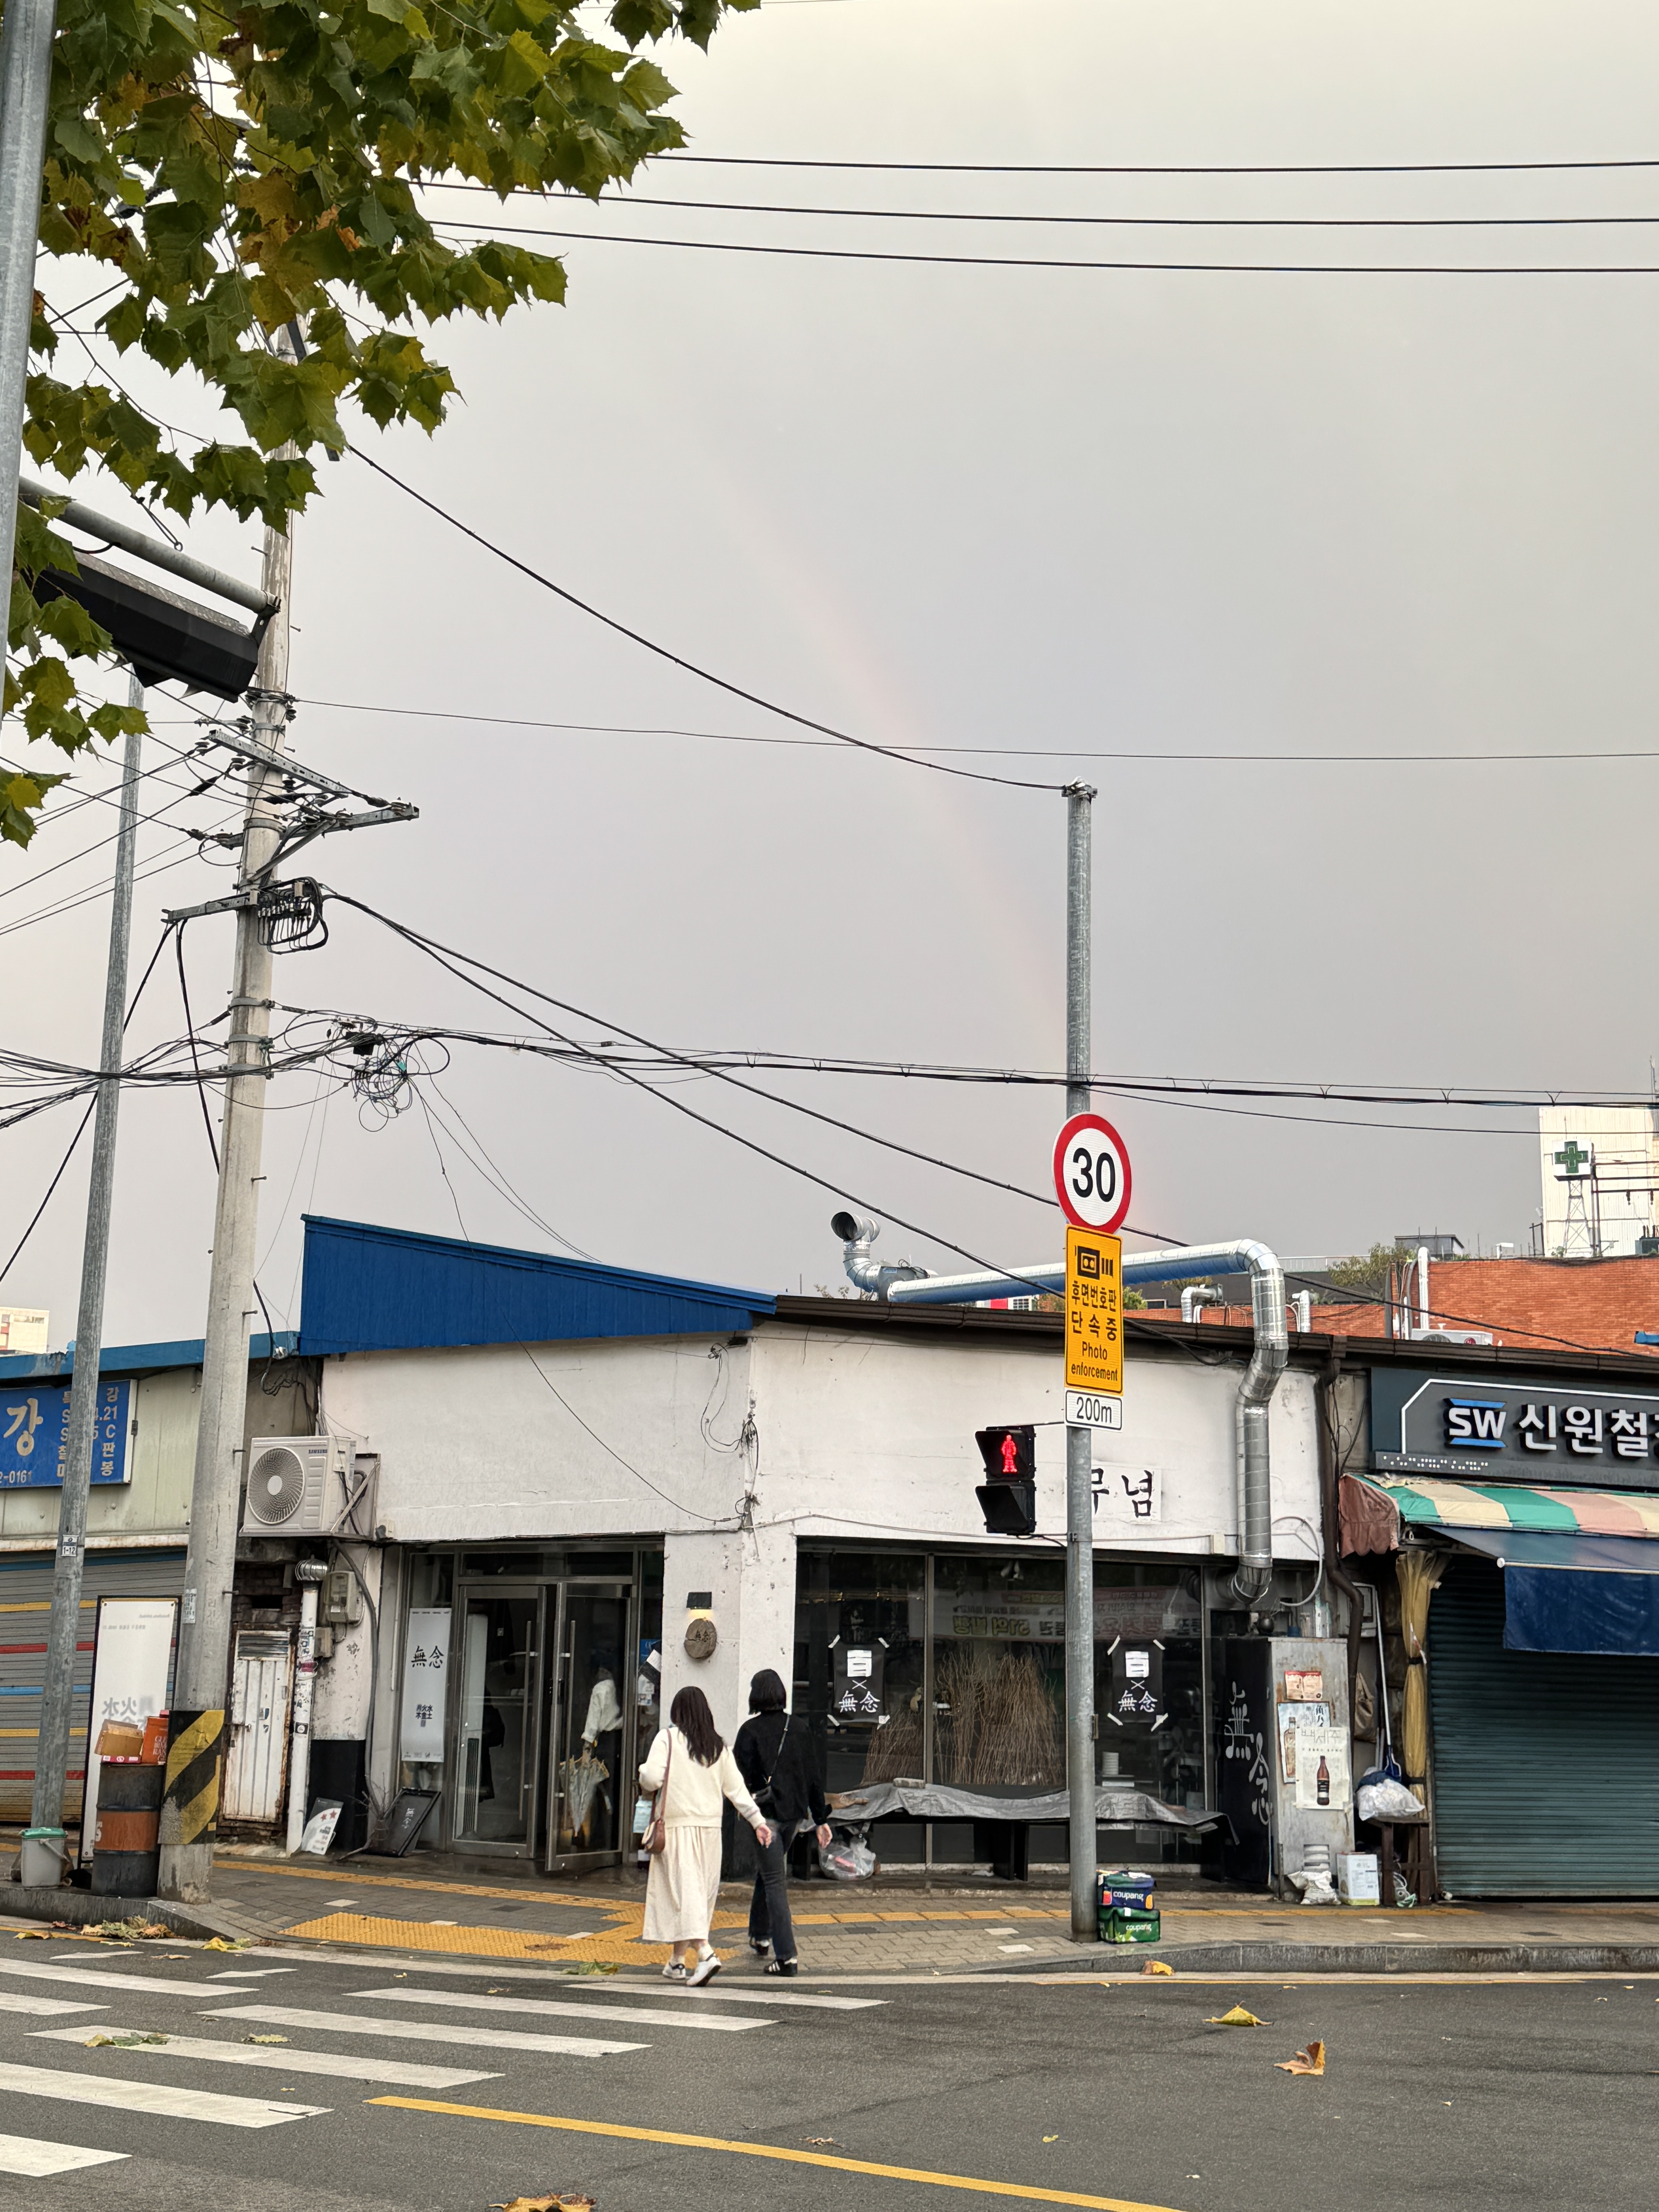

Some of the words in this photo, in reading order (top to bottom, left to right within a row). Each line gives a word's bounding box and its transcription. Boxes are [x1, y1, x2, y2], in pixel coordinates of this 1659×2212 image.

[1072, 1147, 1115, 1202] 30
[1072, 1280, 1116, 1312] 후면번호판
[1082, 1341, 1108, 1360] Photo
[1072, 1362, 1118, 1382] enforcement
[1077, 1396, 1112, 1423] 200m
[1449, 1407, 1507, 1439] SW
[1518, 1404, 1659, 1457] 신원철
[411, 1645, 444, 1669] 無念
[838, 1690, 881, 1713] 無念
[1118, 1690, 1158, 1713] 無念
[1113, 1891, 1144, 1902] coupang
[1126, 1923, 1152, 1932] coupang
